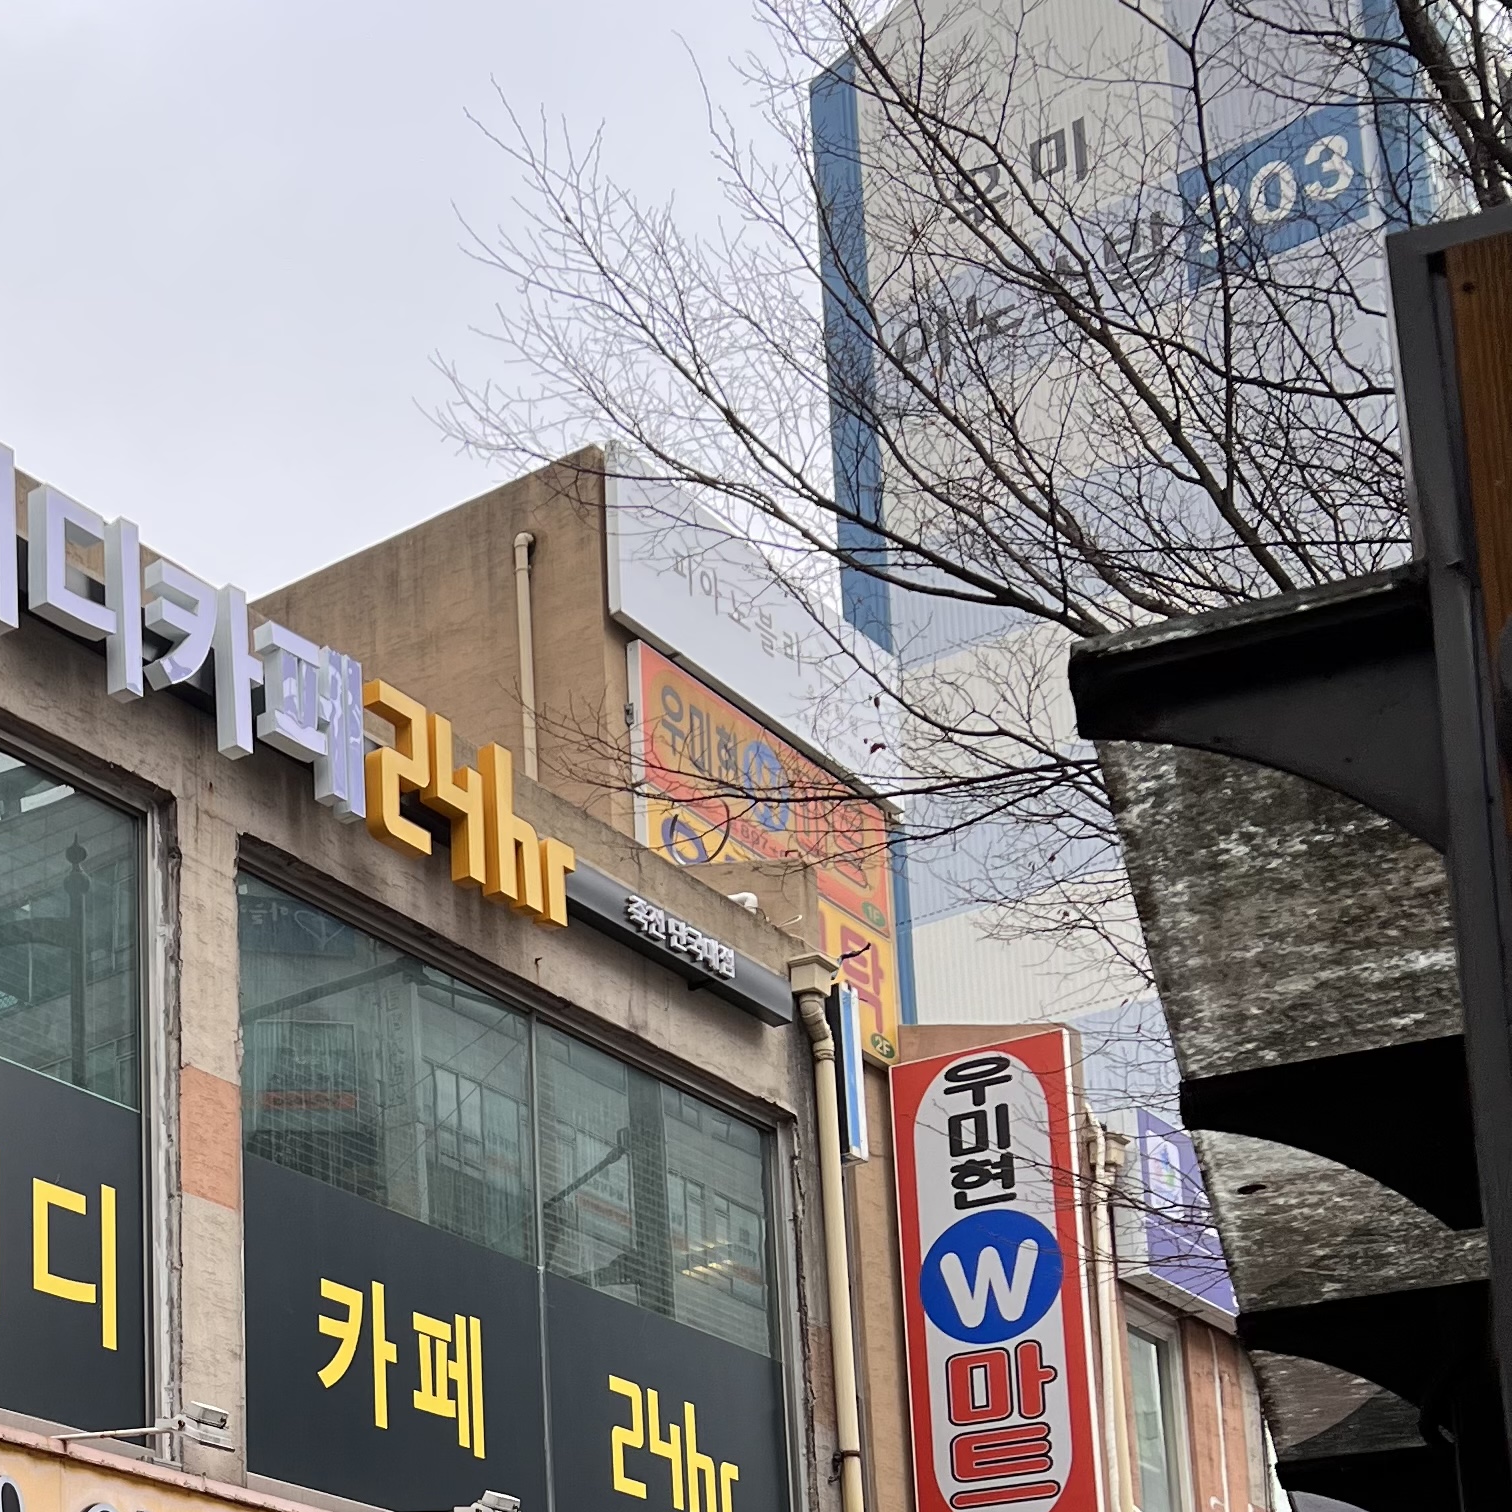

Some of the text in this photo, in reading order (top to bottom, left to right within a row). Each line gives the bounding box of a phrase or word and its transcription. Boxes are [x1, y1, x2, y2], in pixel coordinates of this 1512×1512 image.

[1196, 134, 1356, 254] 203
[944, 1057, 1017, 1210] 우미현
[317, 1277, 486, 1460] 카페
[945, 1339, 1059, 1510] 마트
